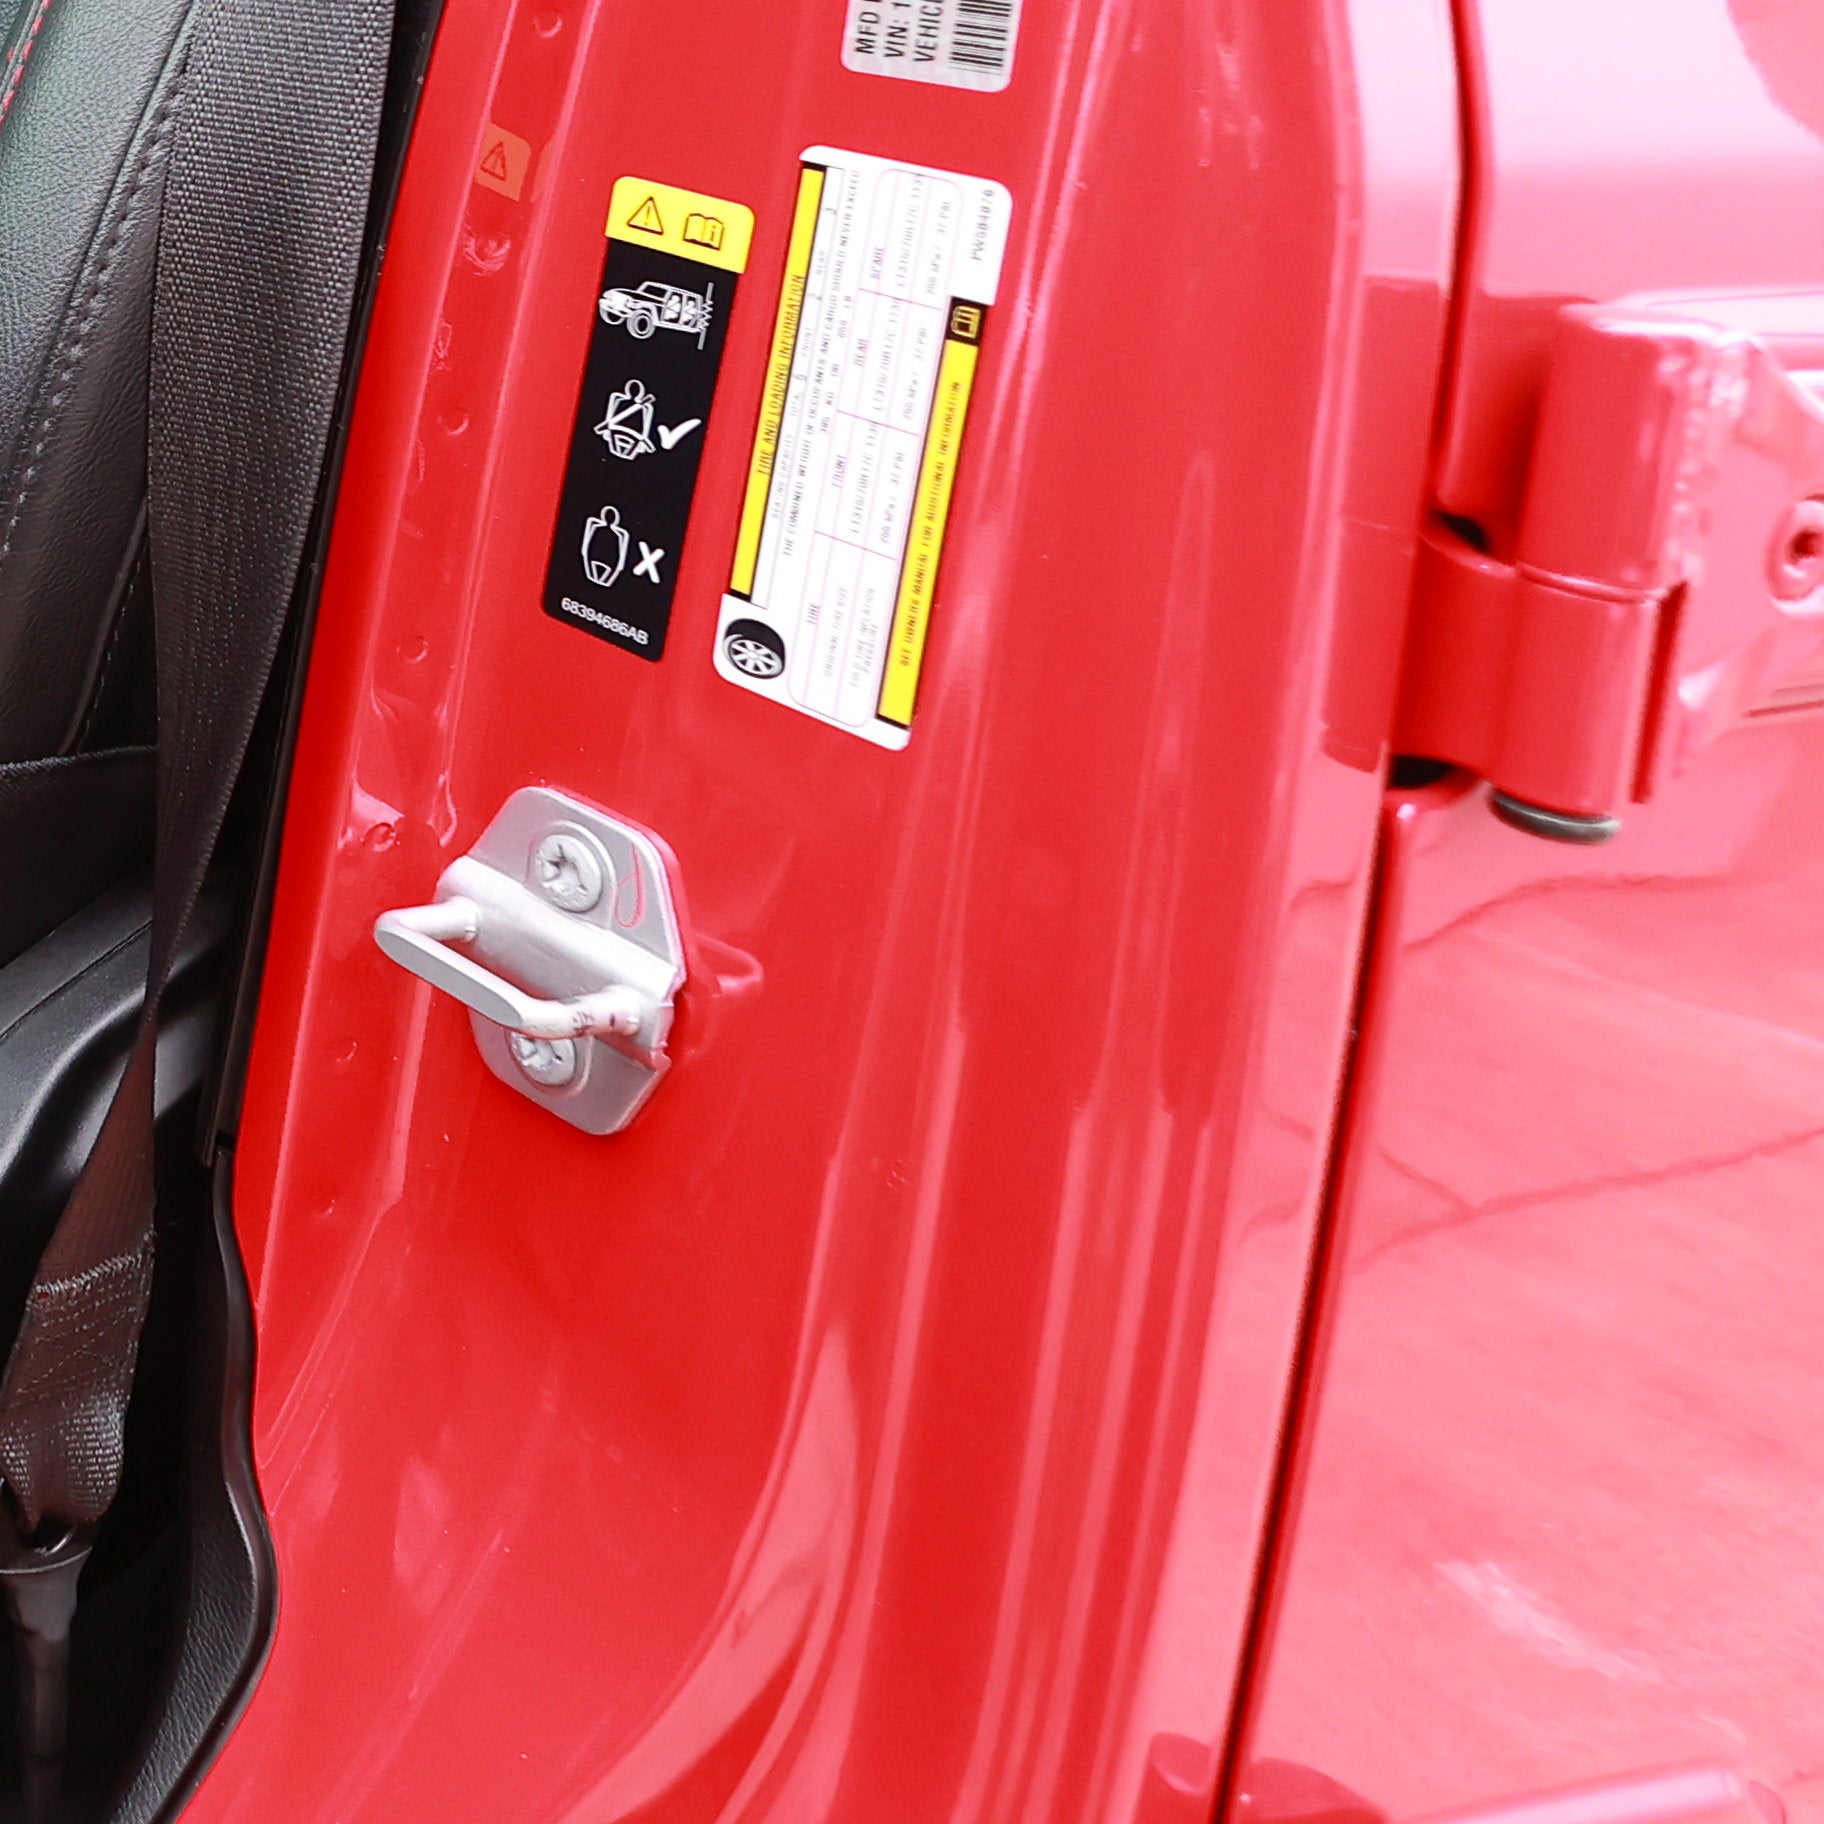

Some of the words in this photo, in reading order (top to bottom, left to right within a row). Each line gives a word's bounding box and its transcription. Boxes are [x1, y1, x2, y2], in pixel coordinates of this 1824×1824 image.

[855, 10, 881, 55] MFD
[884, 18, 911, 60] VIN:
[778, 273, 804, 359] INFORMATION
[768, 362, 788, 417] LOADING
[763, 418, 778, 445] AND
[757, 448, 773, 476] TIRE
